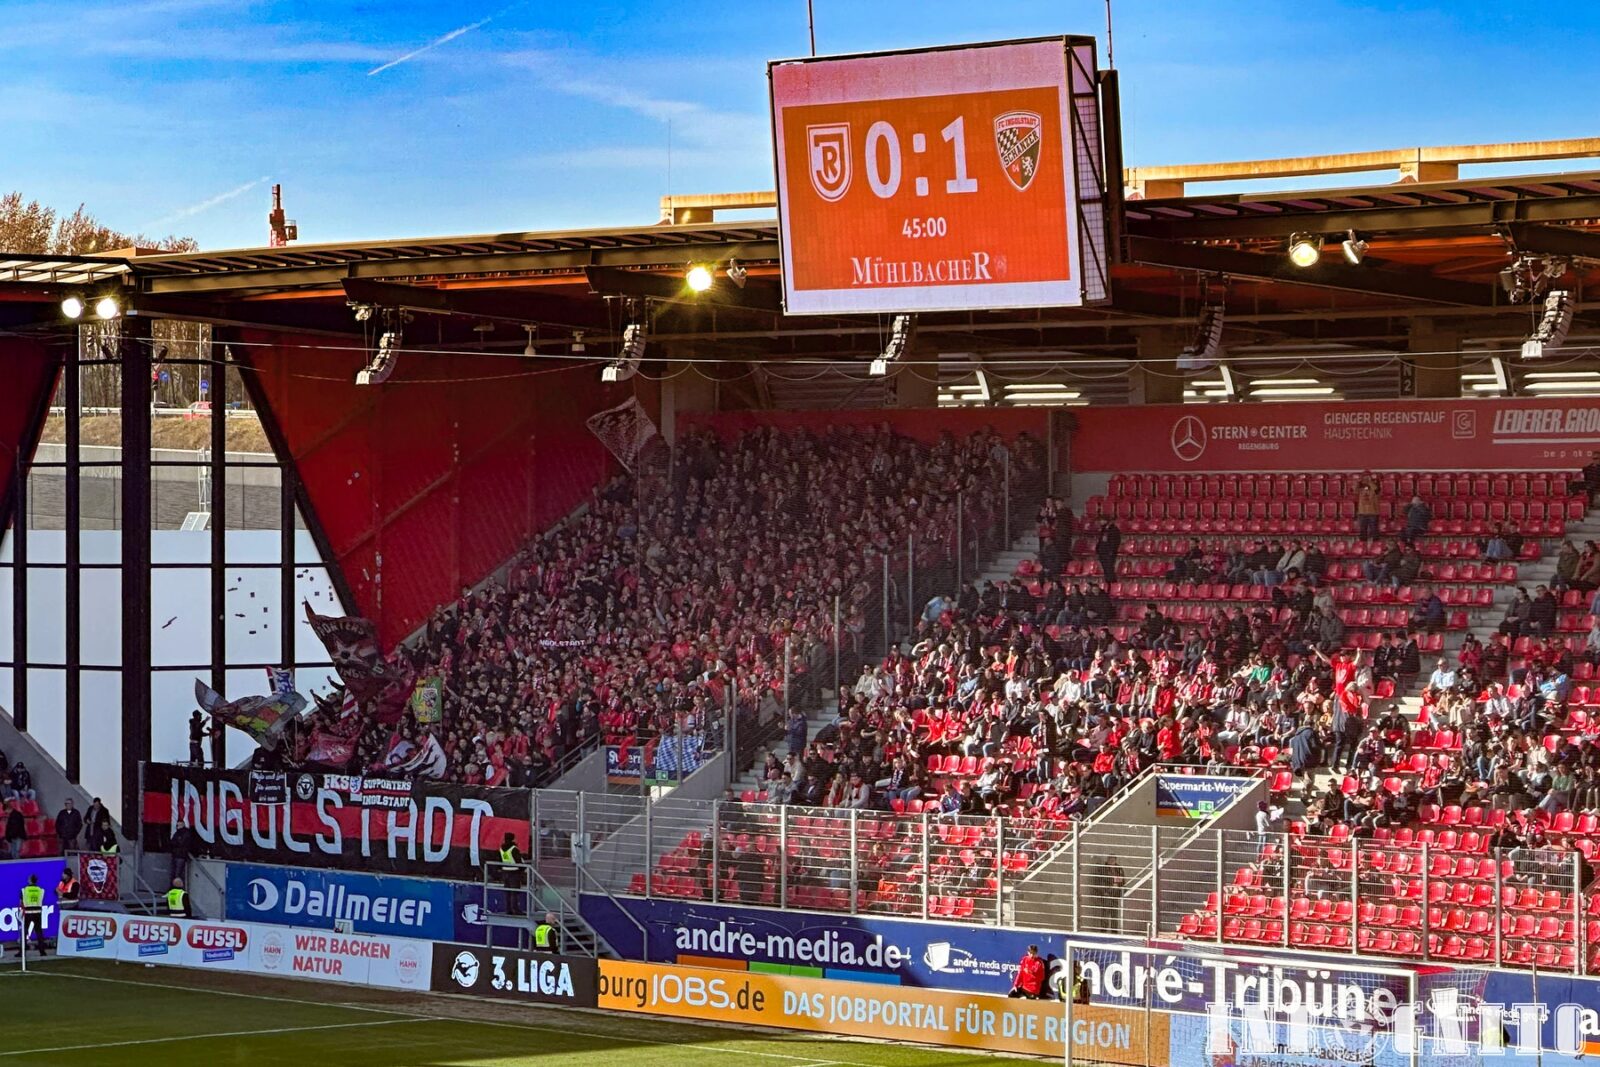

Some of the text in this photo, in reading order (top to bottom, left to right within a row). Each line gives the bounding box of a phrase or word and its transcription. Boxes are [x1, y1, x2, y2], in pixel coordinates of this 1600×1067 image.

[865, 116, 978, 199] 0:1
[902, 217, 947, 238] 45:00
[851, 251, 992, 285] MÜHLBACHER
[1324, 411, 1446, 425] GIENGER REGENSTAUF
[1211, 425, 1307, 440] STERN CENTER
[1324, 427, 1393, 439] HAUSTECHNIK
[323, 774, 350, 790] FKS
[363, 779, 412, 791] SUPPORTERS
[362, 795, 410, 807] INGOLSTADT
[170, 777, 495, 866] INGOLSTADT
[285, 880, 432, 927] Dallmeier
[67, 918, 113, 937] FUSSL
[129, 923, 177, 943] FUSSL
[192, 928, 243, 948] FUSSL
[295, 935, 327, 953] WIR
[330, 938, 391, 959] BACKEN
[676, 921, 901, 968] andre-media.de
[264, 945, 282, 955] HAHN
[293, 955, 343, 975] NATUR
[400, 959, 417, 969] HAHN
[1001, 963, 1021, 973] grou
[491, 956, 575, 997] 3. LIGA
[1049, 951, 1397, 1023] andré-Tribüne
[784, 991, 825, 1018] DAS
[829, 995, 949, 1031] JOBPORTAL
[955, 1003, 996, 1035] FÜR
[1003, 1012, 1039, 1040] DIE
